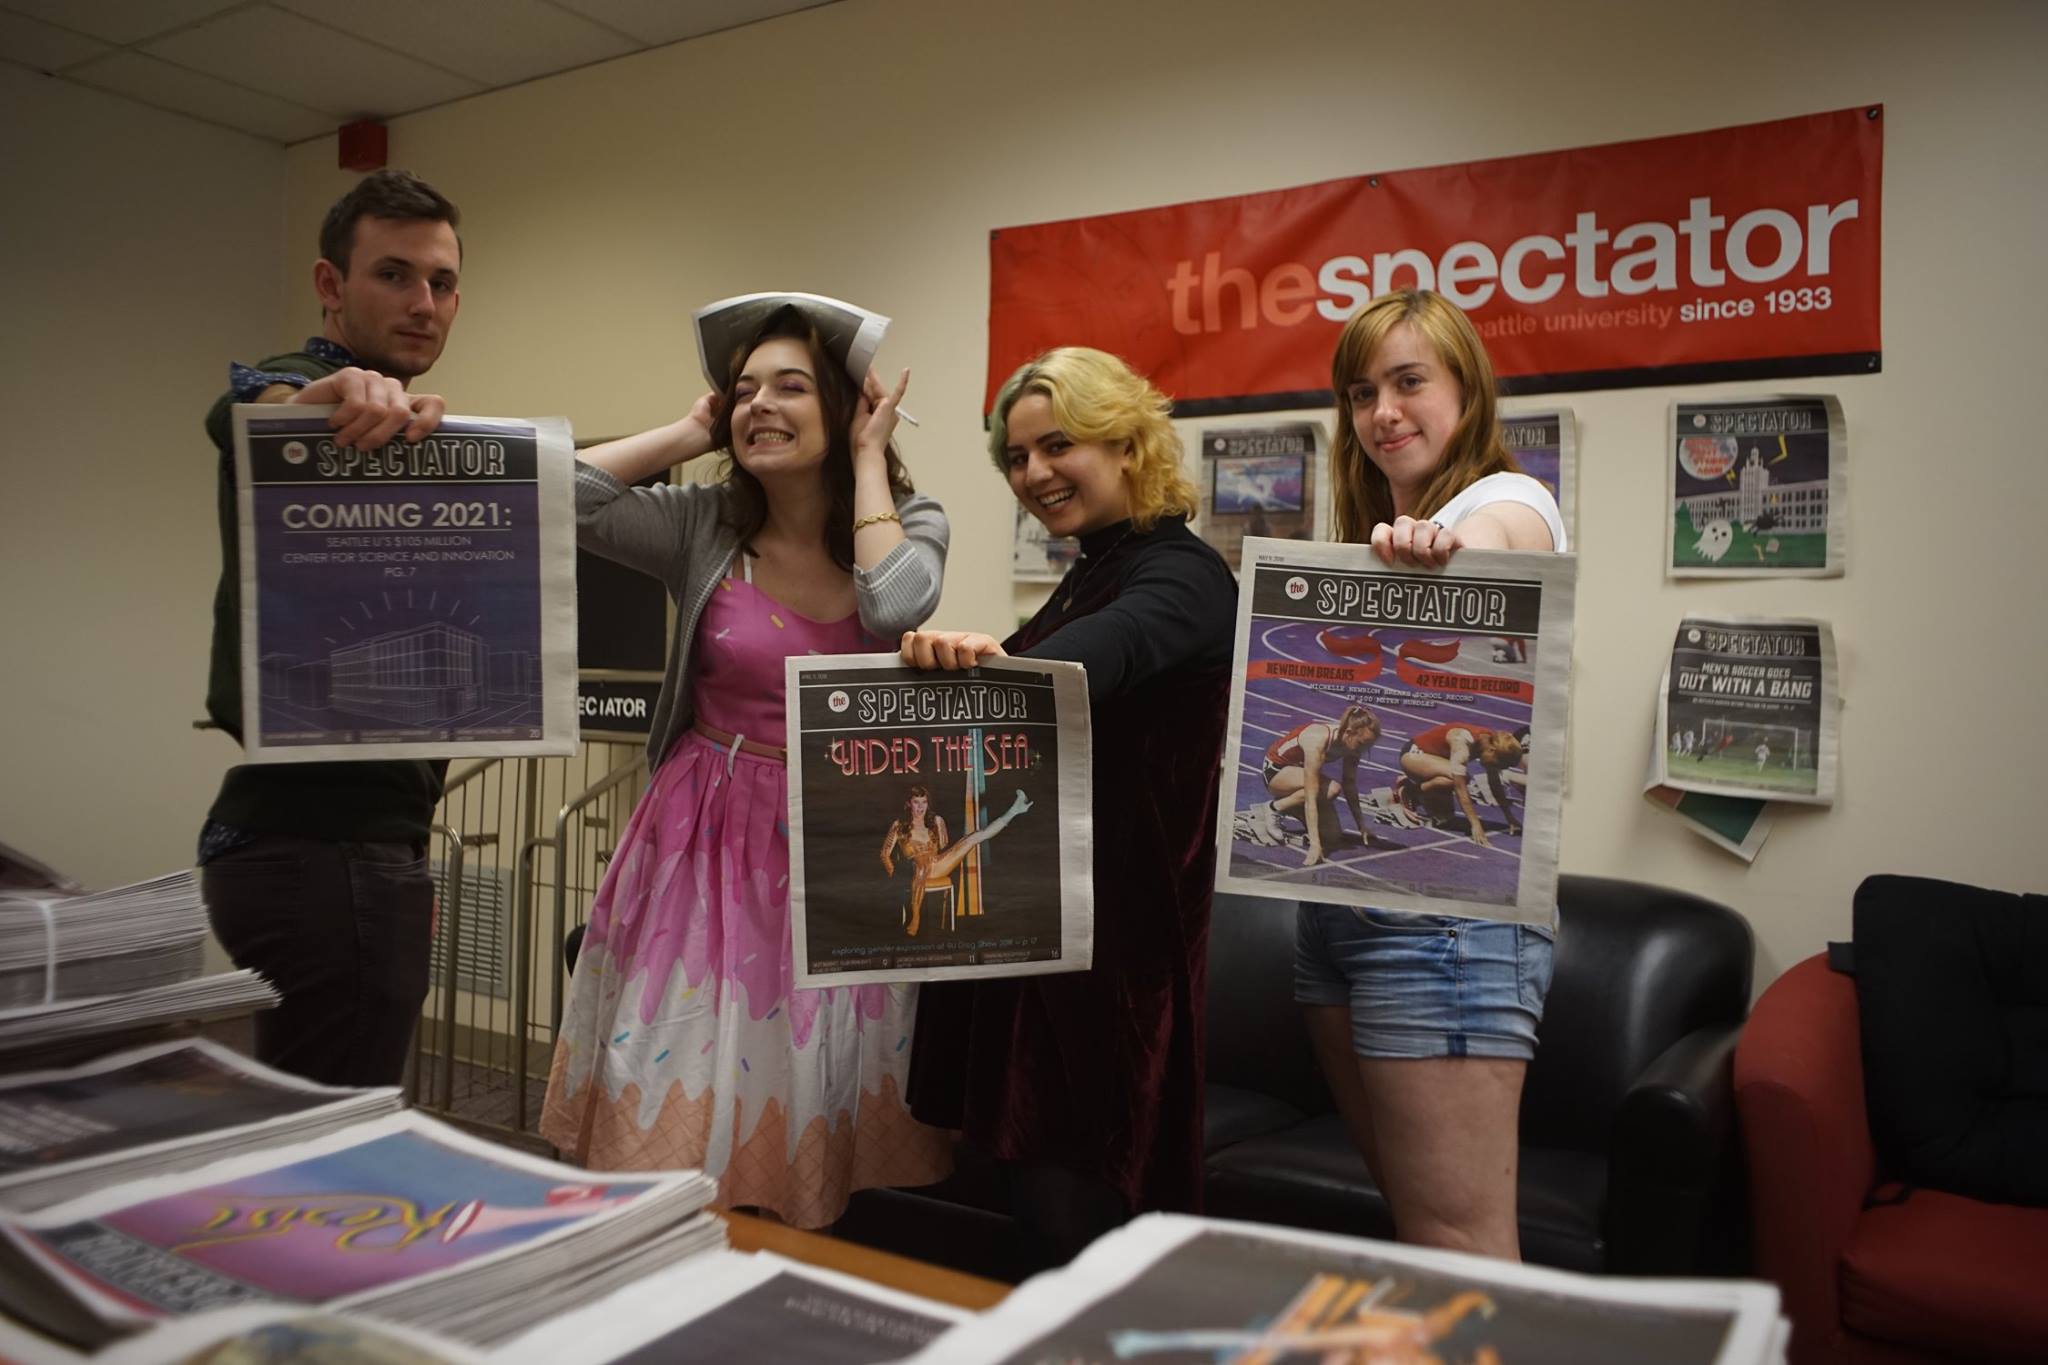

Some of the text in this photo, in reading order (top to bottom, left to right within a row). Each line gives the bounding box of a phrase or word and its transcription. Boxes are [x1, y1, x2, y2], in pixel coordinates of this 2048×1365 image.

[1545, 301, 1673, 332] university
[1680, 297, 1755, 323] since
[1764, 285, 1832, 315] 1933
[1710, 411, 1811, 433] SPECTATOR
[317, 439, 506, 478] SPECTATOR
[282, 502, 512, 529] COMING 2021:
[326, 536, 370, 549] SEATTLE
[395, 535, 422, 547] $105
[425, 534, 472, 547] MILLION
[282, 549, 515, 564] CENTER FOR SCIENCE AND INNOVATION
[409, 566, 417, 577] 7
[1290, 581, 1305, 594] the
[1316, 578, 1506, 627] SPECTATOR
[1705, 630, 1805, 656] SPECTATOR
[1266, 662, 1355, 681] NEWBLOM BREAKS
[1731, 664, 1766, 678] SOCCER
[1767, 667, 1792, 679] GOES
[1416, 673, 1520, 694] 42 YEAR OLD RECORD
[1679, 672, 1813, 699] OUT WITH A BANG
[833, 694, 847, 707] the
[858, 686, 1028, 723] SPECTATOR
[1446, 693, 1474, 702] RECORD
[832, 733, 1029, 777] UNDER THE SEA
